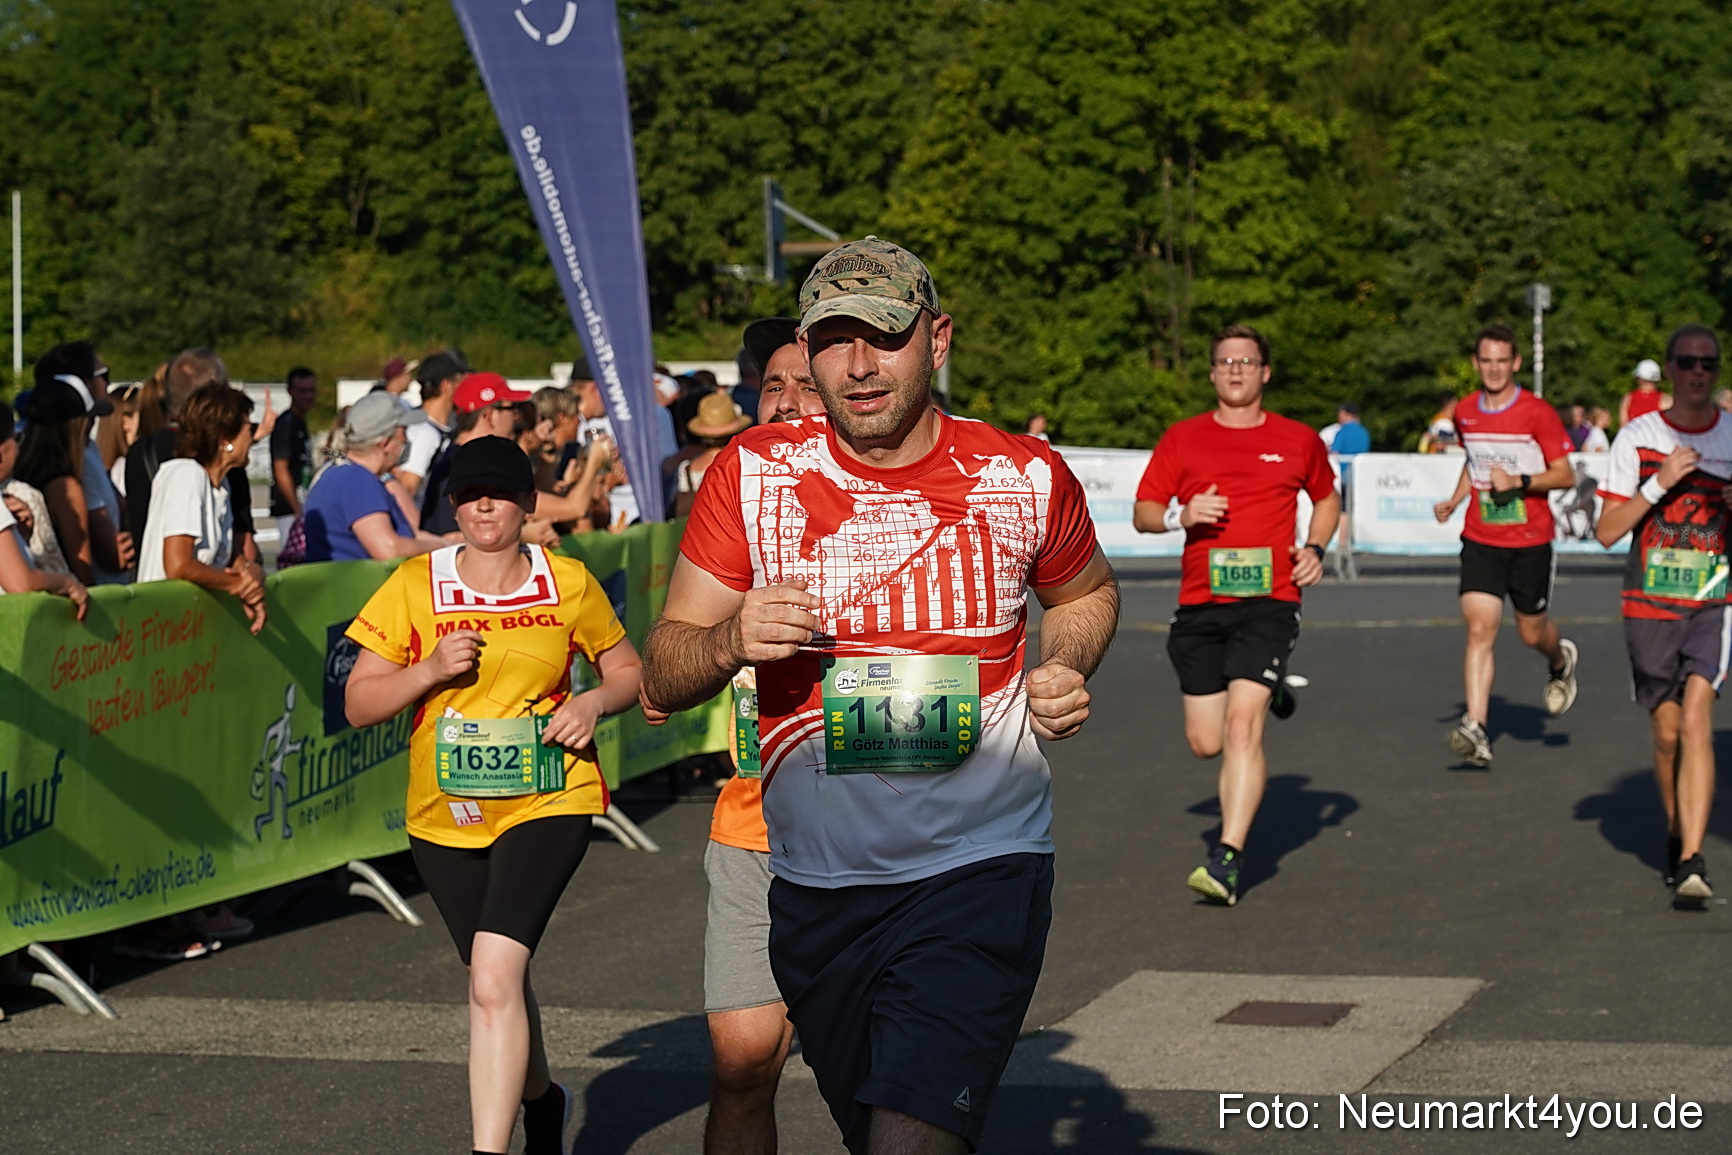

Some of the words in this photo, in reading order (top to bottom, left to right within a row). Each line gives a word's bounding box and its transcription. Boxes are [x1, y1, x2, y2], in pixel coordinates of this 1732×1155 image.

[1221, 566, 1263, 582] 1683
[435, 618, 493, 638] MAX
[501, 611, 564, 630] BÖGL
[831, 711, 846, 751] RUN
[958, 702, 972, 755] 2022
[738, 729, 748, 759] RUN
[852, 737, 885, 751] Götz
[888, 738, 949, 750] Matthias
[440, 752, 450, 779] RUN
[451, 745, 520, 771] 1632
[522, 747, 532, 783] 2022
[450, 772, 480, 781] Wunsch
[482, 773, 523, 781] Anastasia
